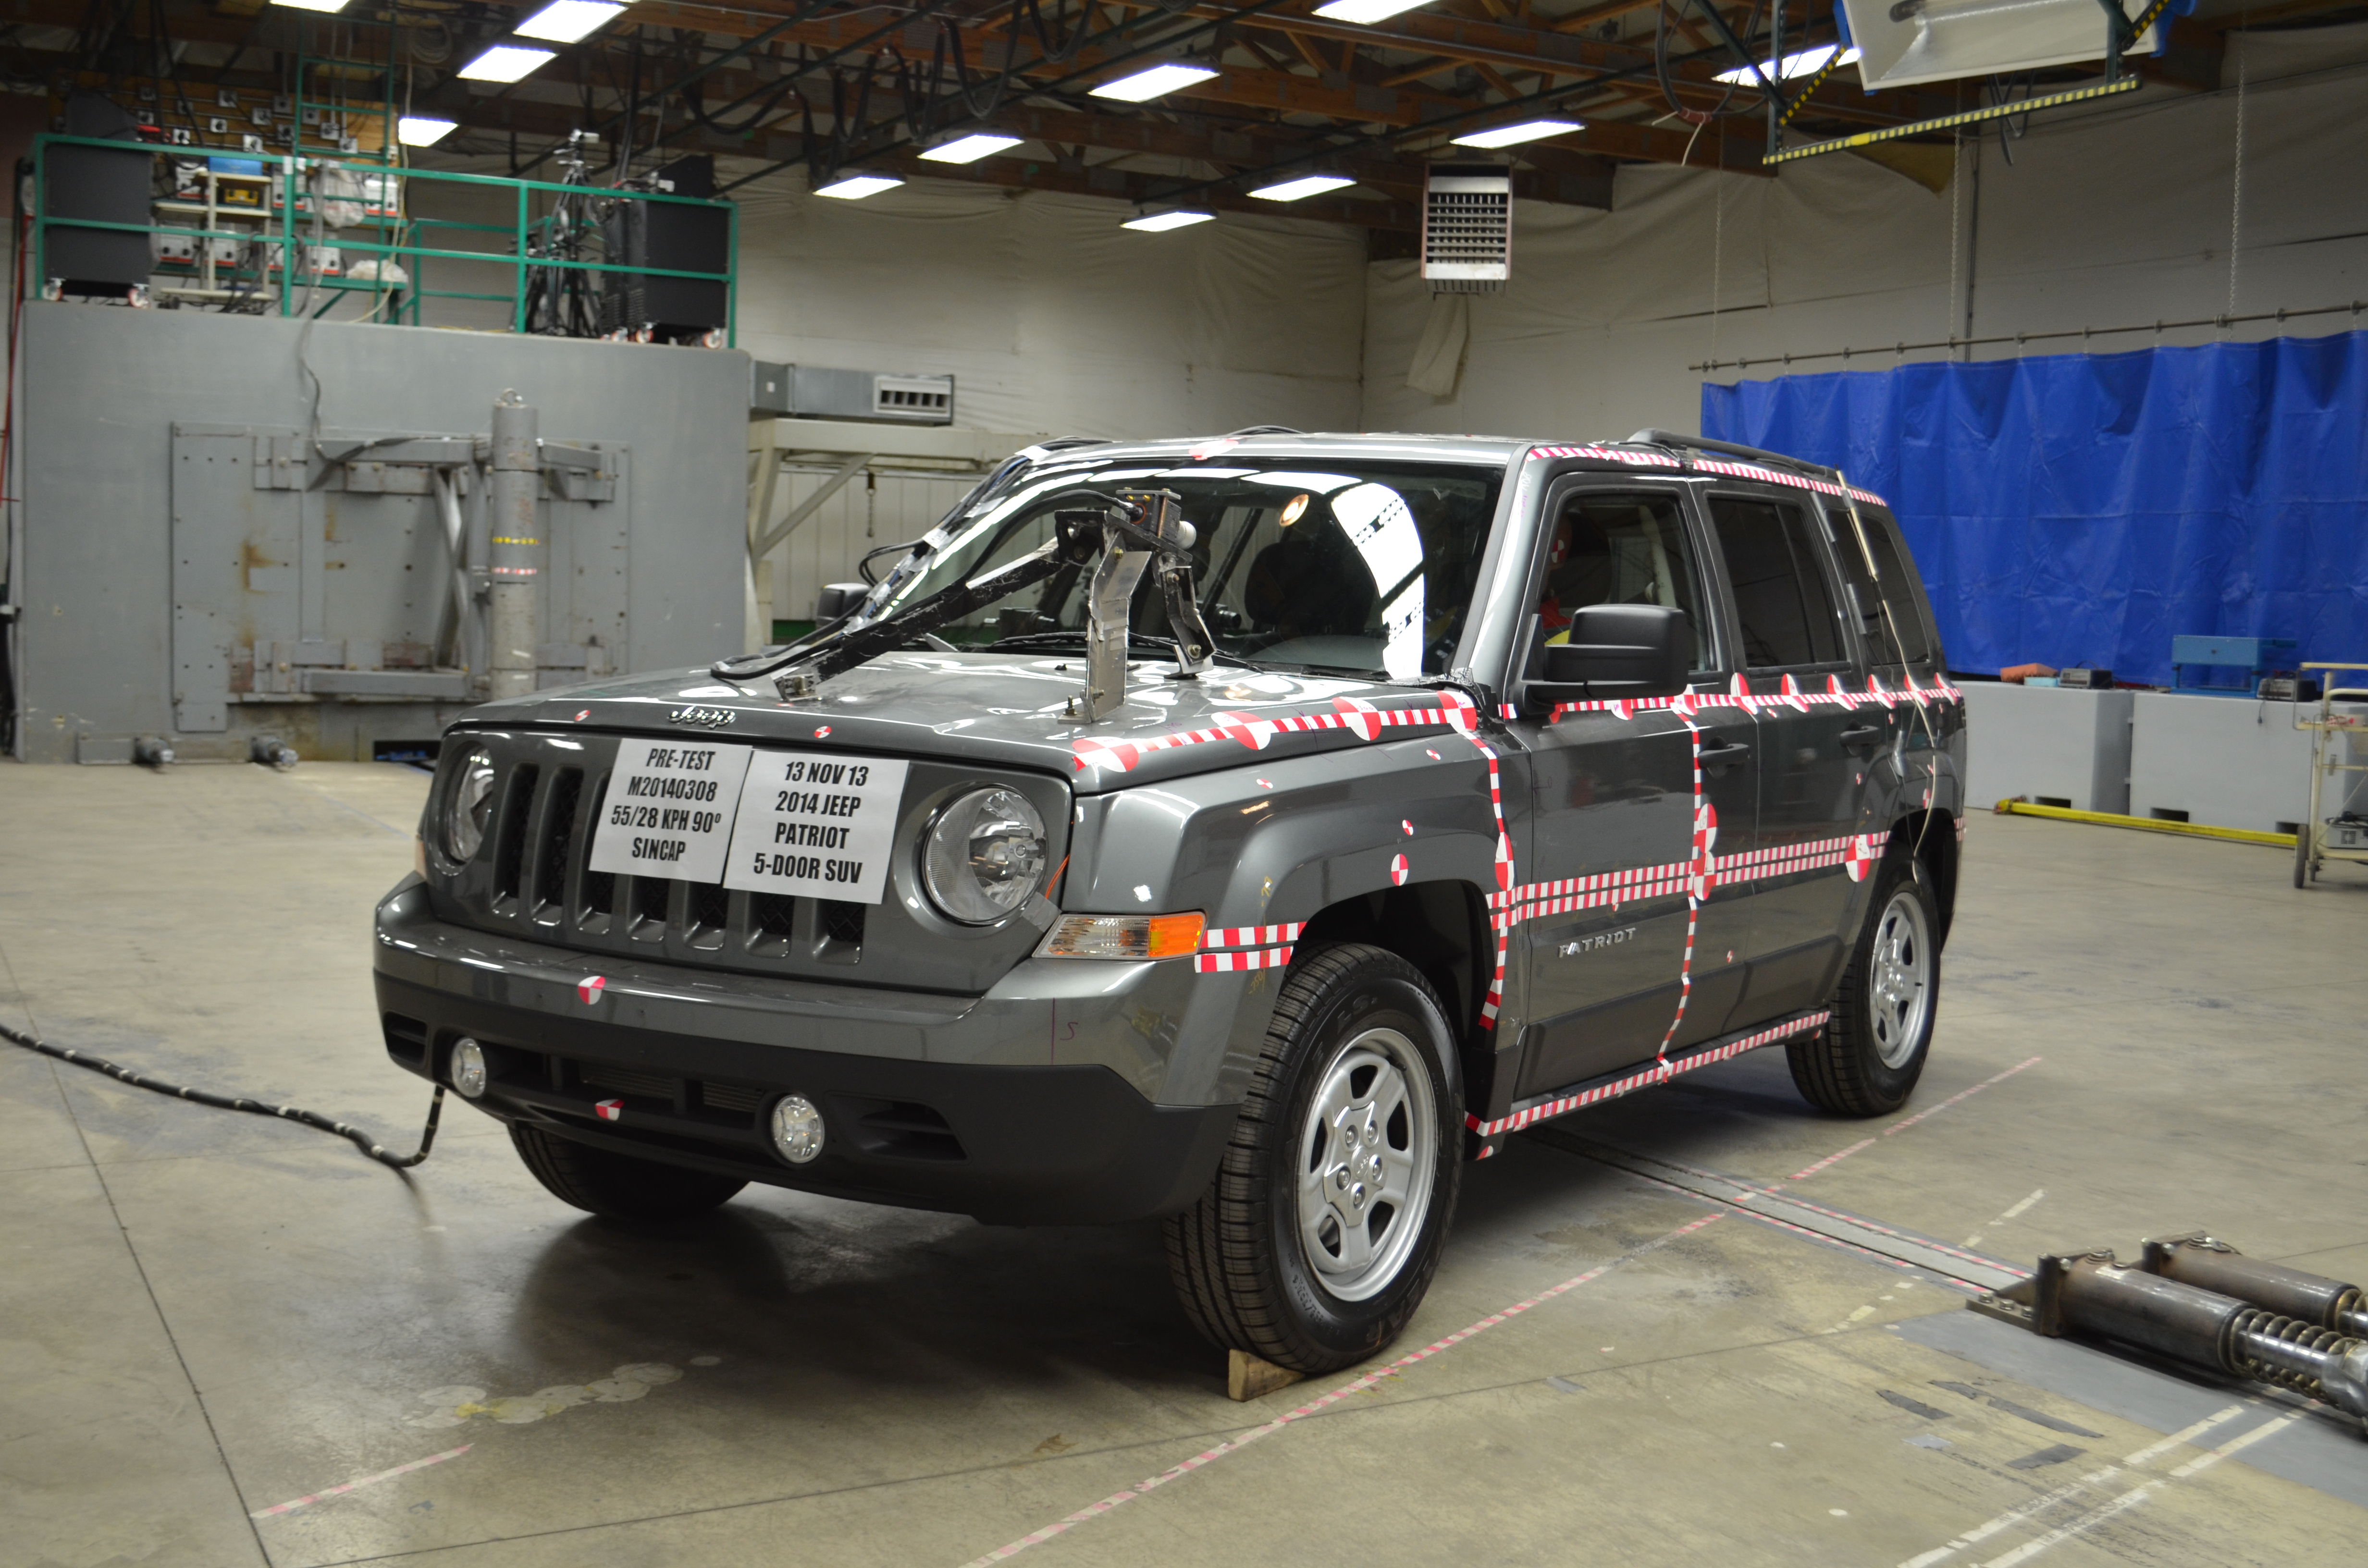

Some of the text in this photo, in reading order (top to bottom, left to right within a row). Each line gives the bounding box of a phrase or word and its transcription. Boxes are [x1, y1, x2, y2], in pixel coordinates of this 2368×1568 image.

[669, 705, 736, 729] Jeep
[646, 748, 716, 771] PRE-TEST
[785, 761, 870, 787] 13 NOV 13
[627, 776, 718, 802] M20140308
[775, 791, 862, 818] 2014 JEEP
[611, 805, 658, 829] 55/28
[661, 808, 691, 831] KPH
[775, 822, 851, 849] PATRIOT
[632, 837, 686, 862] SINCAP
[753, 852, 863, 884] 5-DOOR SUV
[1558, 927, 1636, 958] PATRIOT
